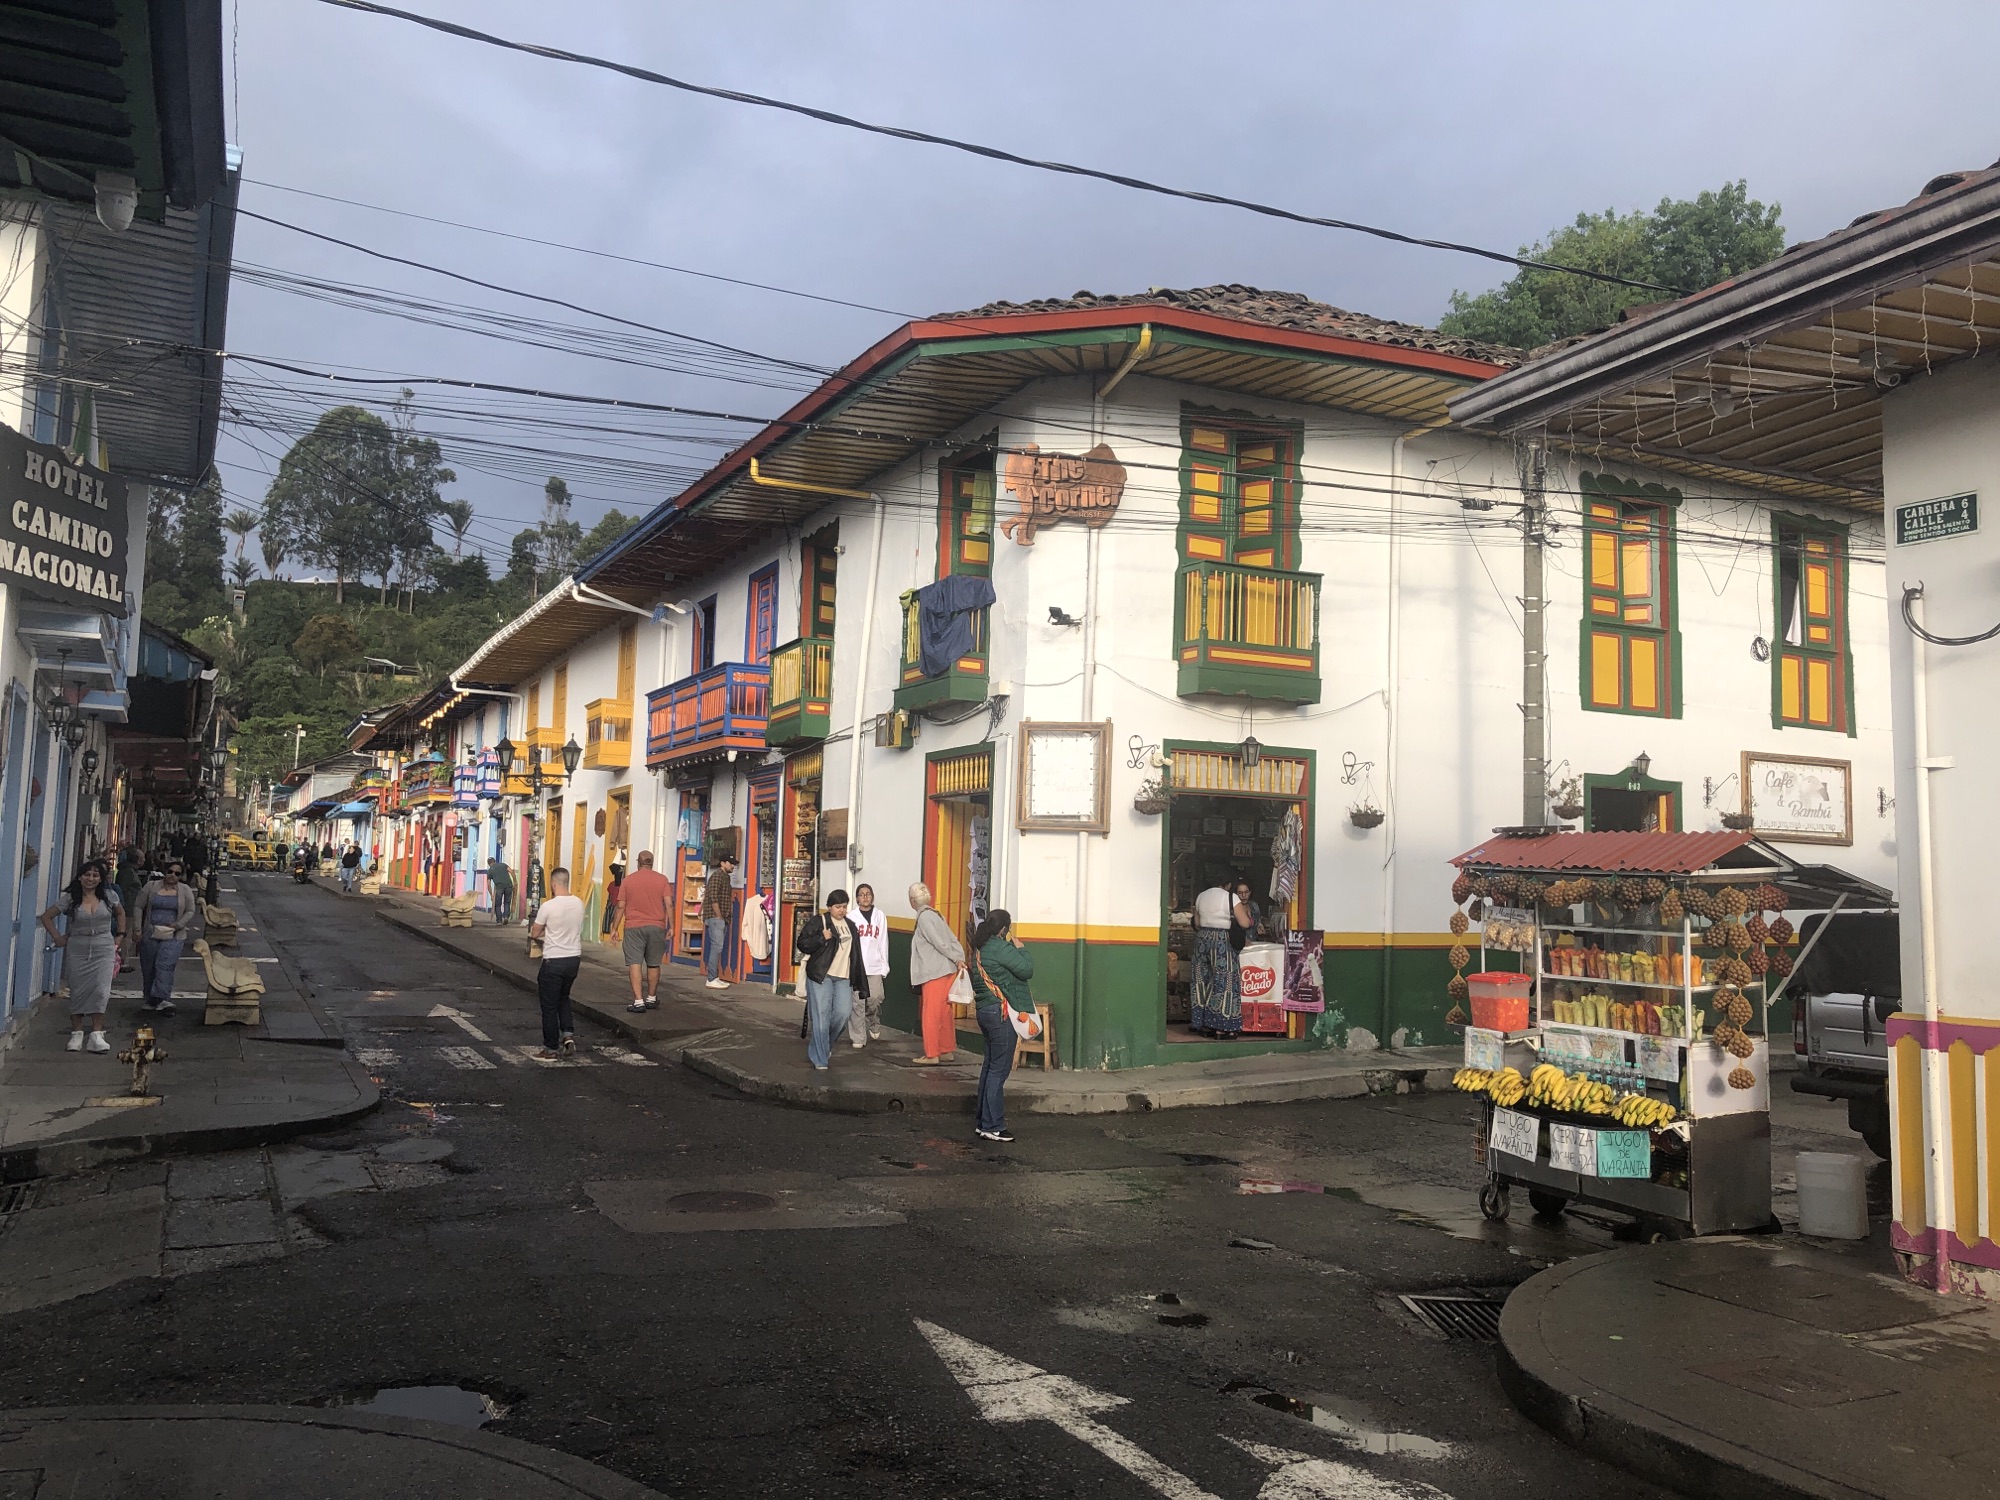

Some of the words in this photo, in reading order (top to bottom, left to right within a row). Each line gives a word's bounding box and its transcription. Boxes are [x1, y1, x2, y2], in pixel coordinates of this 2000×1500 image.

[1037, 457, 1084, 481] The
[24, 450, 108, 510] HOTEL
[1040, 485, 1124, 514] Corner
[1904, 500, 1956, 519] CARRERA
[1961, 498, 1969, 509] 6
[12, 500, 113, 558] CAMINO
[1903, 527, 1928, 536] UNIDOS
[1942, 519, 1971, 528] SALENTO
[1904, 513, 1944, 530] CALLE
[1960, 509, 1969, 519] 4
[1920, 529, 1946, 539] SENTIDO
[1947, 525, 1970, 533] SOCIAL
[0, 539, 123, 603] NACIONAL
[1766, 770, 1795, 791] Café
[1777, 794, 1785, 807] &
[1788, 800, 1832, 818] Bambú
[1241, 969, 1270, 982] Crem
[1241, 979, 1272, 994] Helado
[1497, 1109, 1531, 1133] JUGO
[1510, 1128, 1522, 1140] DE
[1603, 1131, 1642, 1148] JUGO
[1493, 1133, 1534, 1157] NARANJA
[1617, 1149, 1630, 1159] DE
[1600, 1160, 1649, 1176] NARANJA
